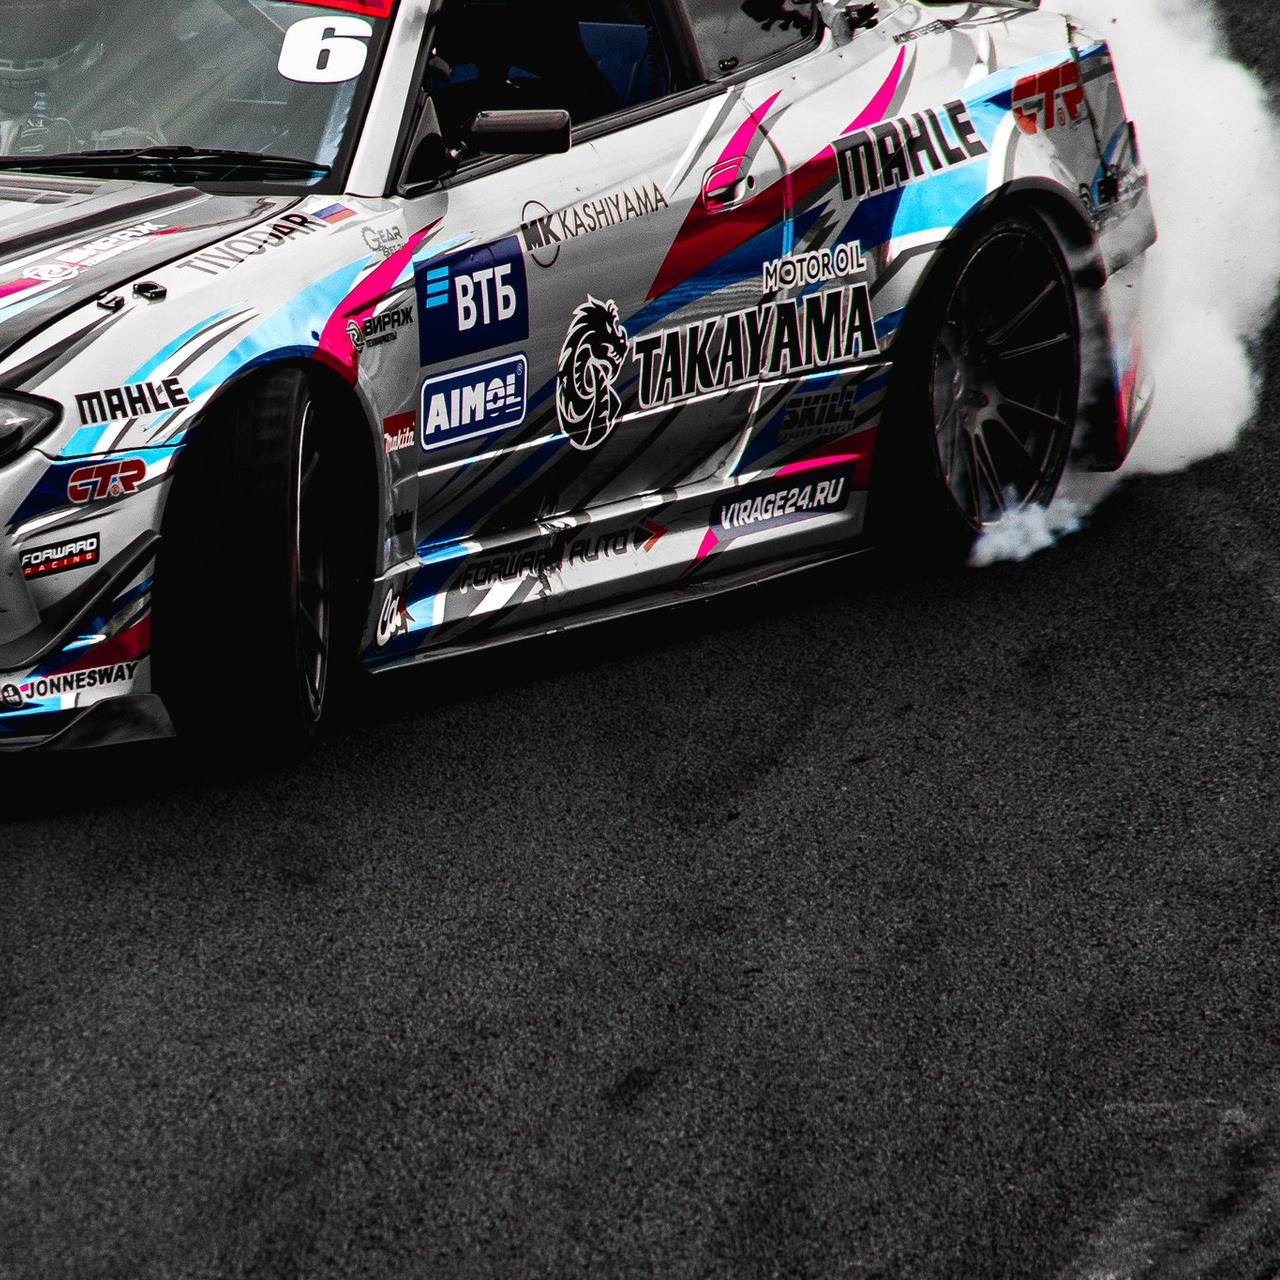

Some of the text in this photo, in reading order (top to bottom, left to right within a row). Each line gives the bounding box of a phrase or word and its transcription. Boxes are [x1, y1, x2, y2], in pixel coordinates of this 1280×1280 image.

[277, 16, 373, 84] 6
[831, 99, 989, 201] MAHLE
[558, 181, 669, 240] KASHIYAMA
[762, 240, 868, 294] MOTOR OIL
[454, 262, 517, 332] ВТБ
[632, 281, 881, 410] TAKAYAMA
[74, 376, 191, 425] MAHLE
[425, 373, 522, 435] AIMOL
[67, 457, 147, 504] CTR
[721, 477, 846, 531] VIRAGE24.RU
[22, 537, 98, 567] FORWARD
[24, 552, 93, 575] RACING
[25, 662, 139, 699] JONNESWAY
